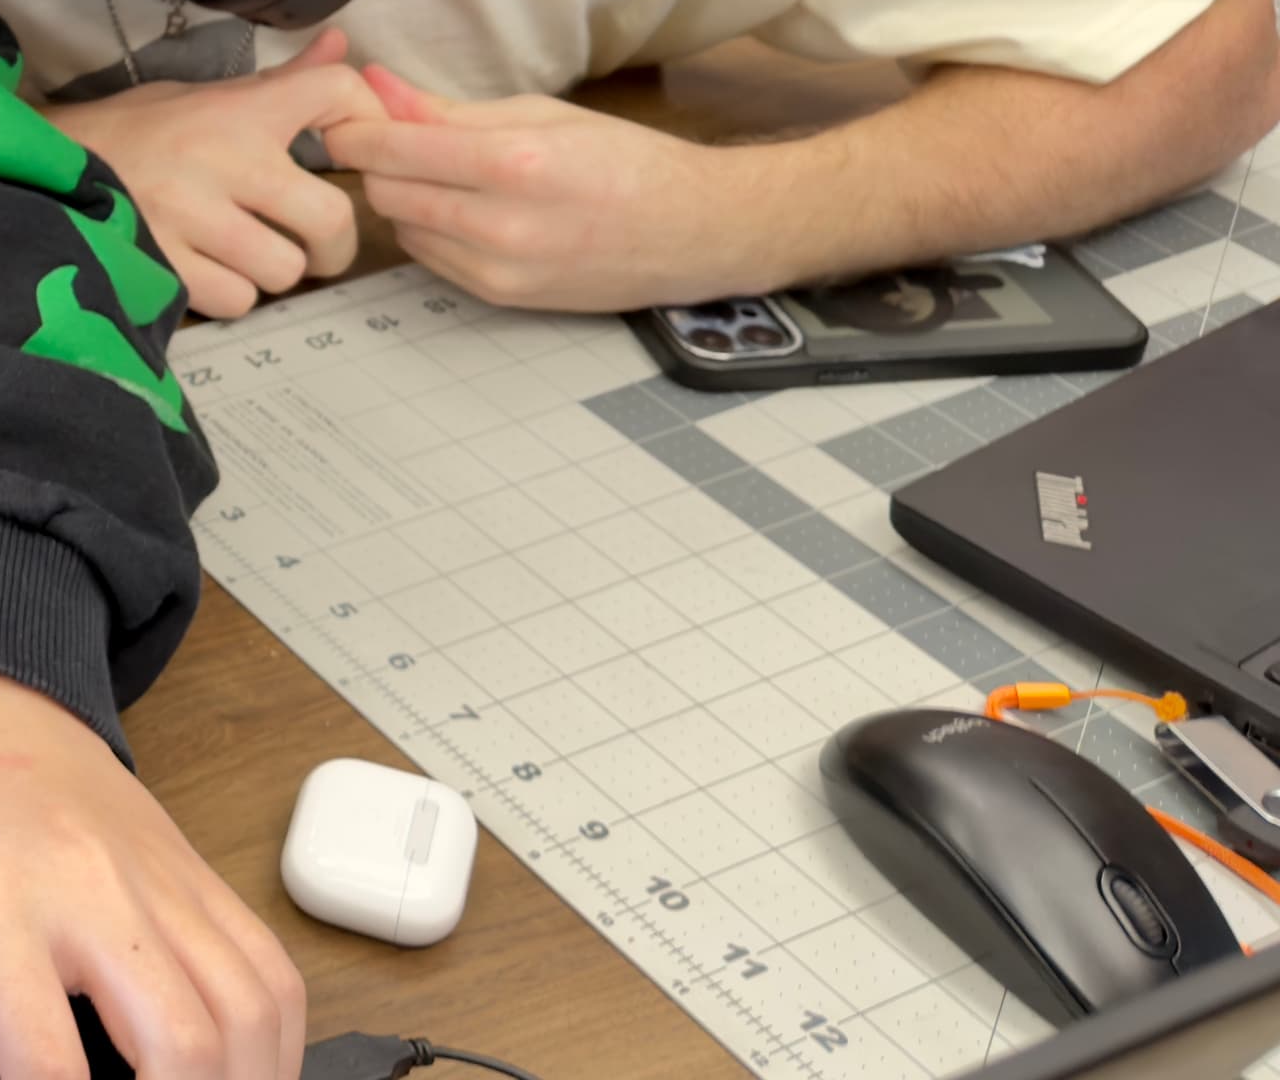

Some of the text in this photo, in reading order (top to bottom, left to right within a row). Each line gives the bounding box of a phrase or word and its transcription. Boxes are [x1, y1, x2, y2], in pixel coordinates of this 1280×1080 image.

[305, 331, 343, 350] 20
[244, 349, 281, 368] 21
[182, 367, 222, 386] 22
[219, 506, 849, 1054] 3 4 5 6 7 8 9 10 11 12
